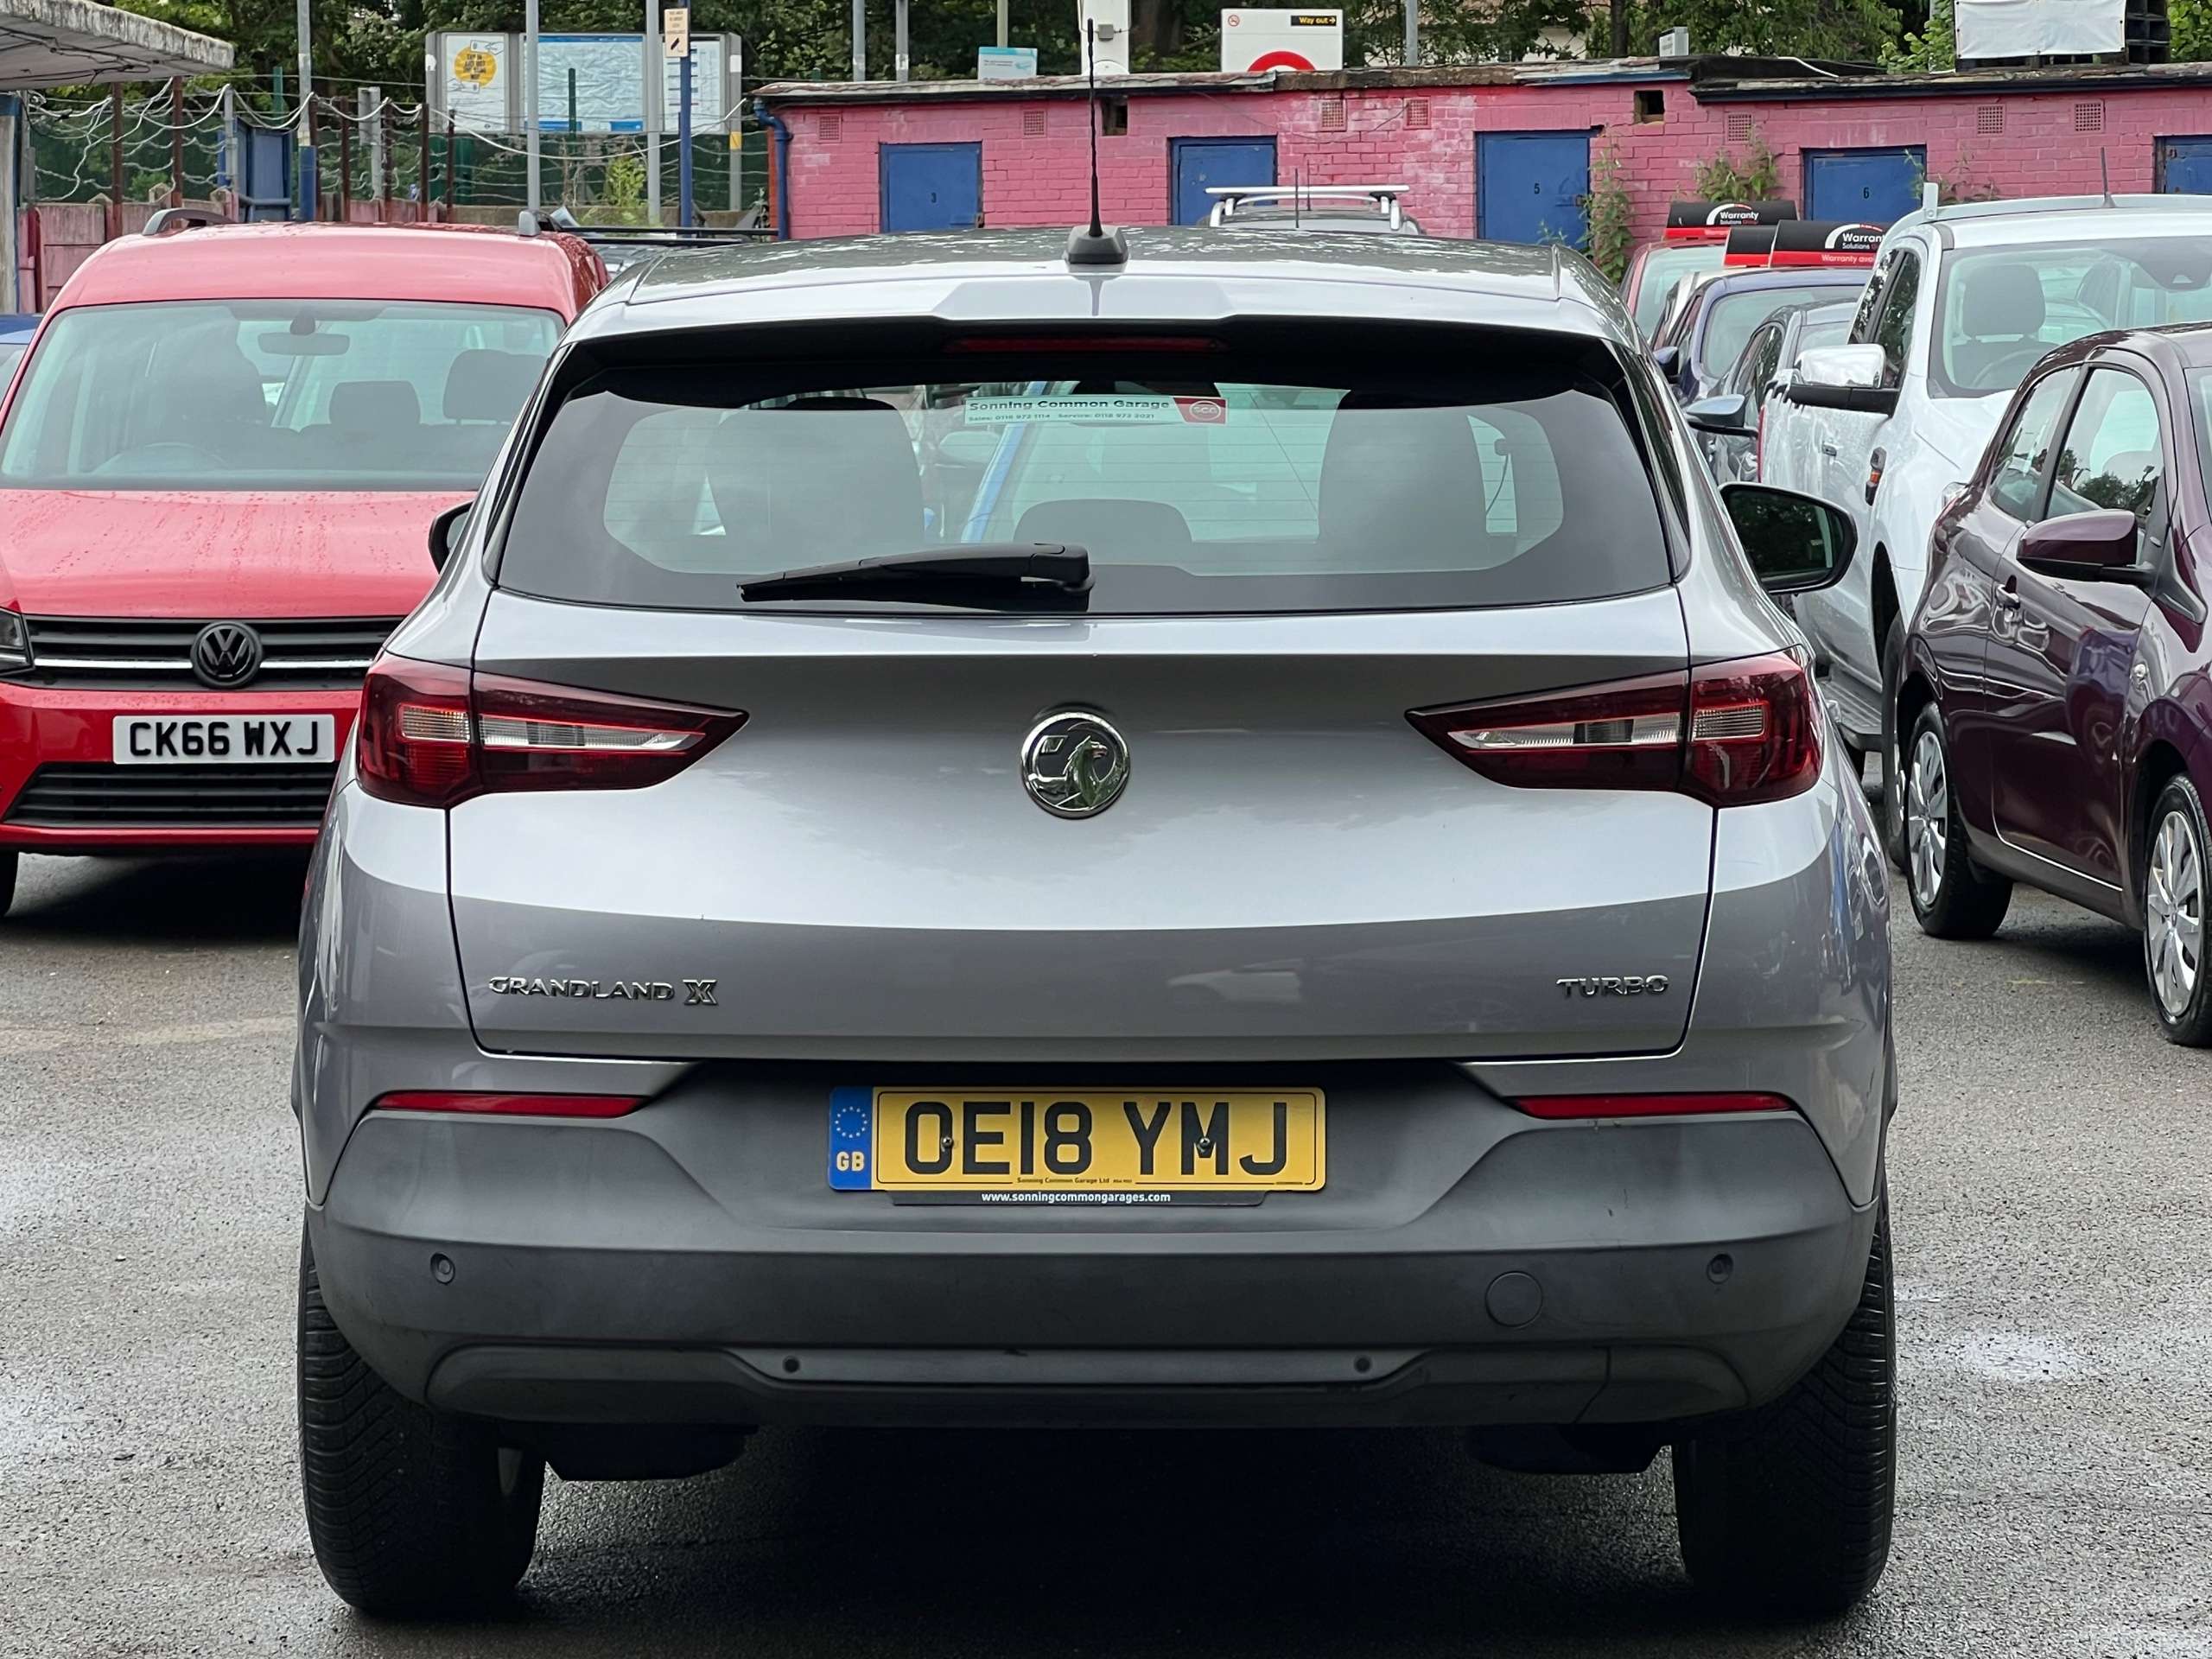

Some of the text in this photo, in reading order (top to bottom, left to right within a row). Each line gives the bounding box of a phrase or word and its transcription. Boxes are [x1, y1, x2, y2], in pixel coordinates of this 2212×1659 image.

[1300, 16, 1314, 25] Way
[1534, 182, 1541, 194] 5
[1863, 187, 1870, 200] 6
[1719, 212, 1759, 221] Warranty
[1842, 232, 1885, 243] Warrant
[1821, 254, 1858, 264] Warranty
[969, 400, 1169, 411] Sonning Common Garage
[130, 721, 318, 757] CK66 WXJ
[488, 976, 719, 1006] GRANDLAND X
[1555, 974, 1670, 999] TURBO
[904, 1101, 1287, 1176] OE18 YMJ
[836, 1151, 865, 1172] GB
[981, 1191, 1172, 1205] www.sonningcommongarages.com
